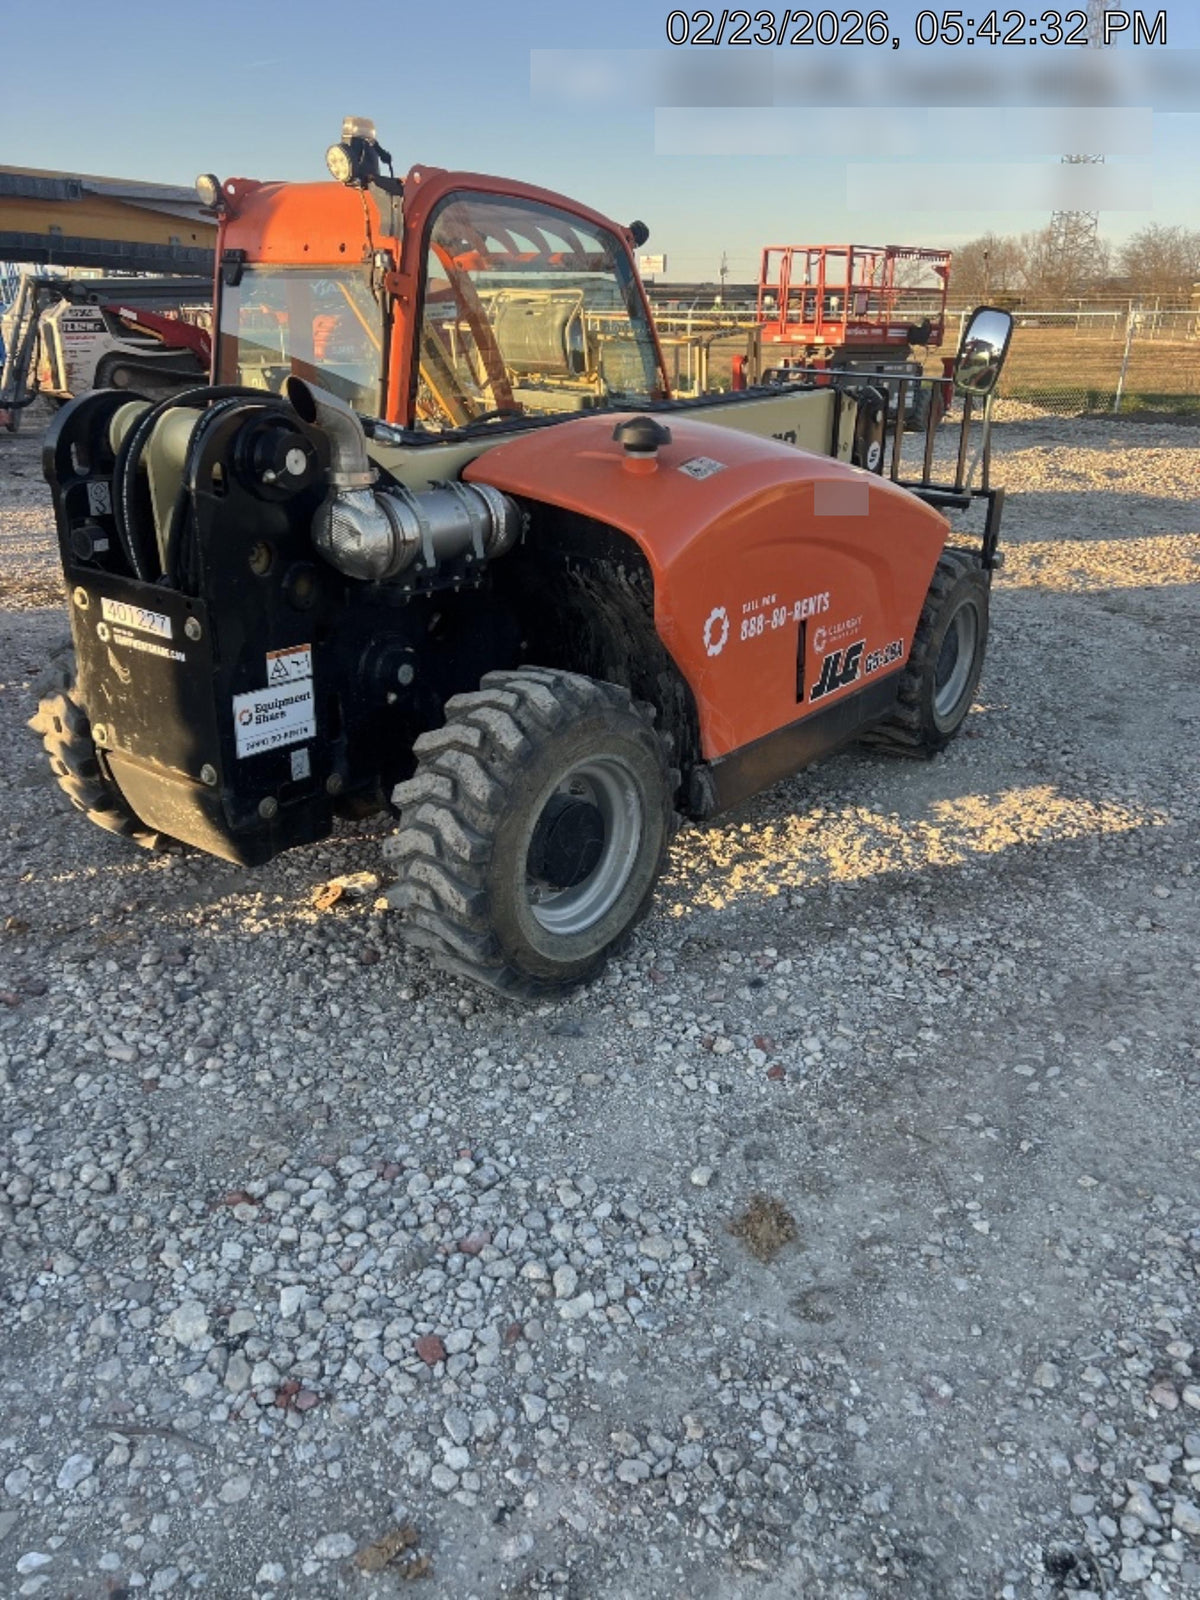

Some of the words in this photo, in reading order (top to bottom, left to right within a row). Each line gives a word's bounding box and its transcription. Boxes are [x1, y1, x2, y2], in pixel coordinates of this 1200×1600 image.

[107, 601, 167, 634] 401227
[808, 637, 867, 704] JLG
[254, 691, 312, 713] Equipment
[255, 710, 287, 725] Share
